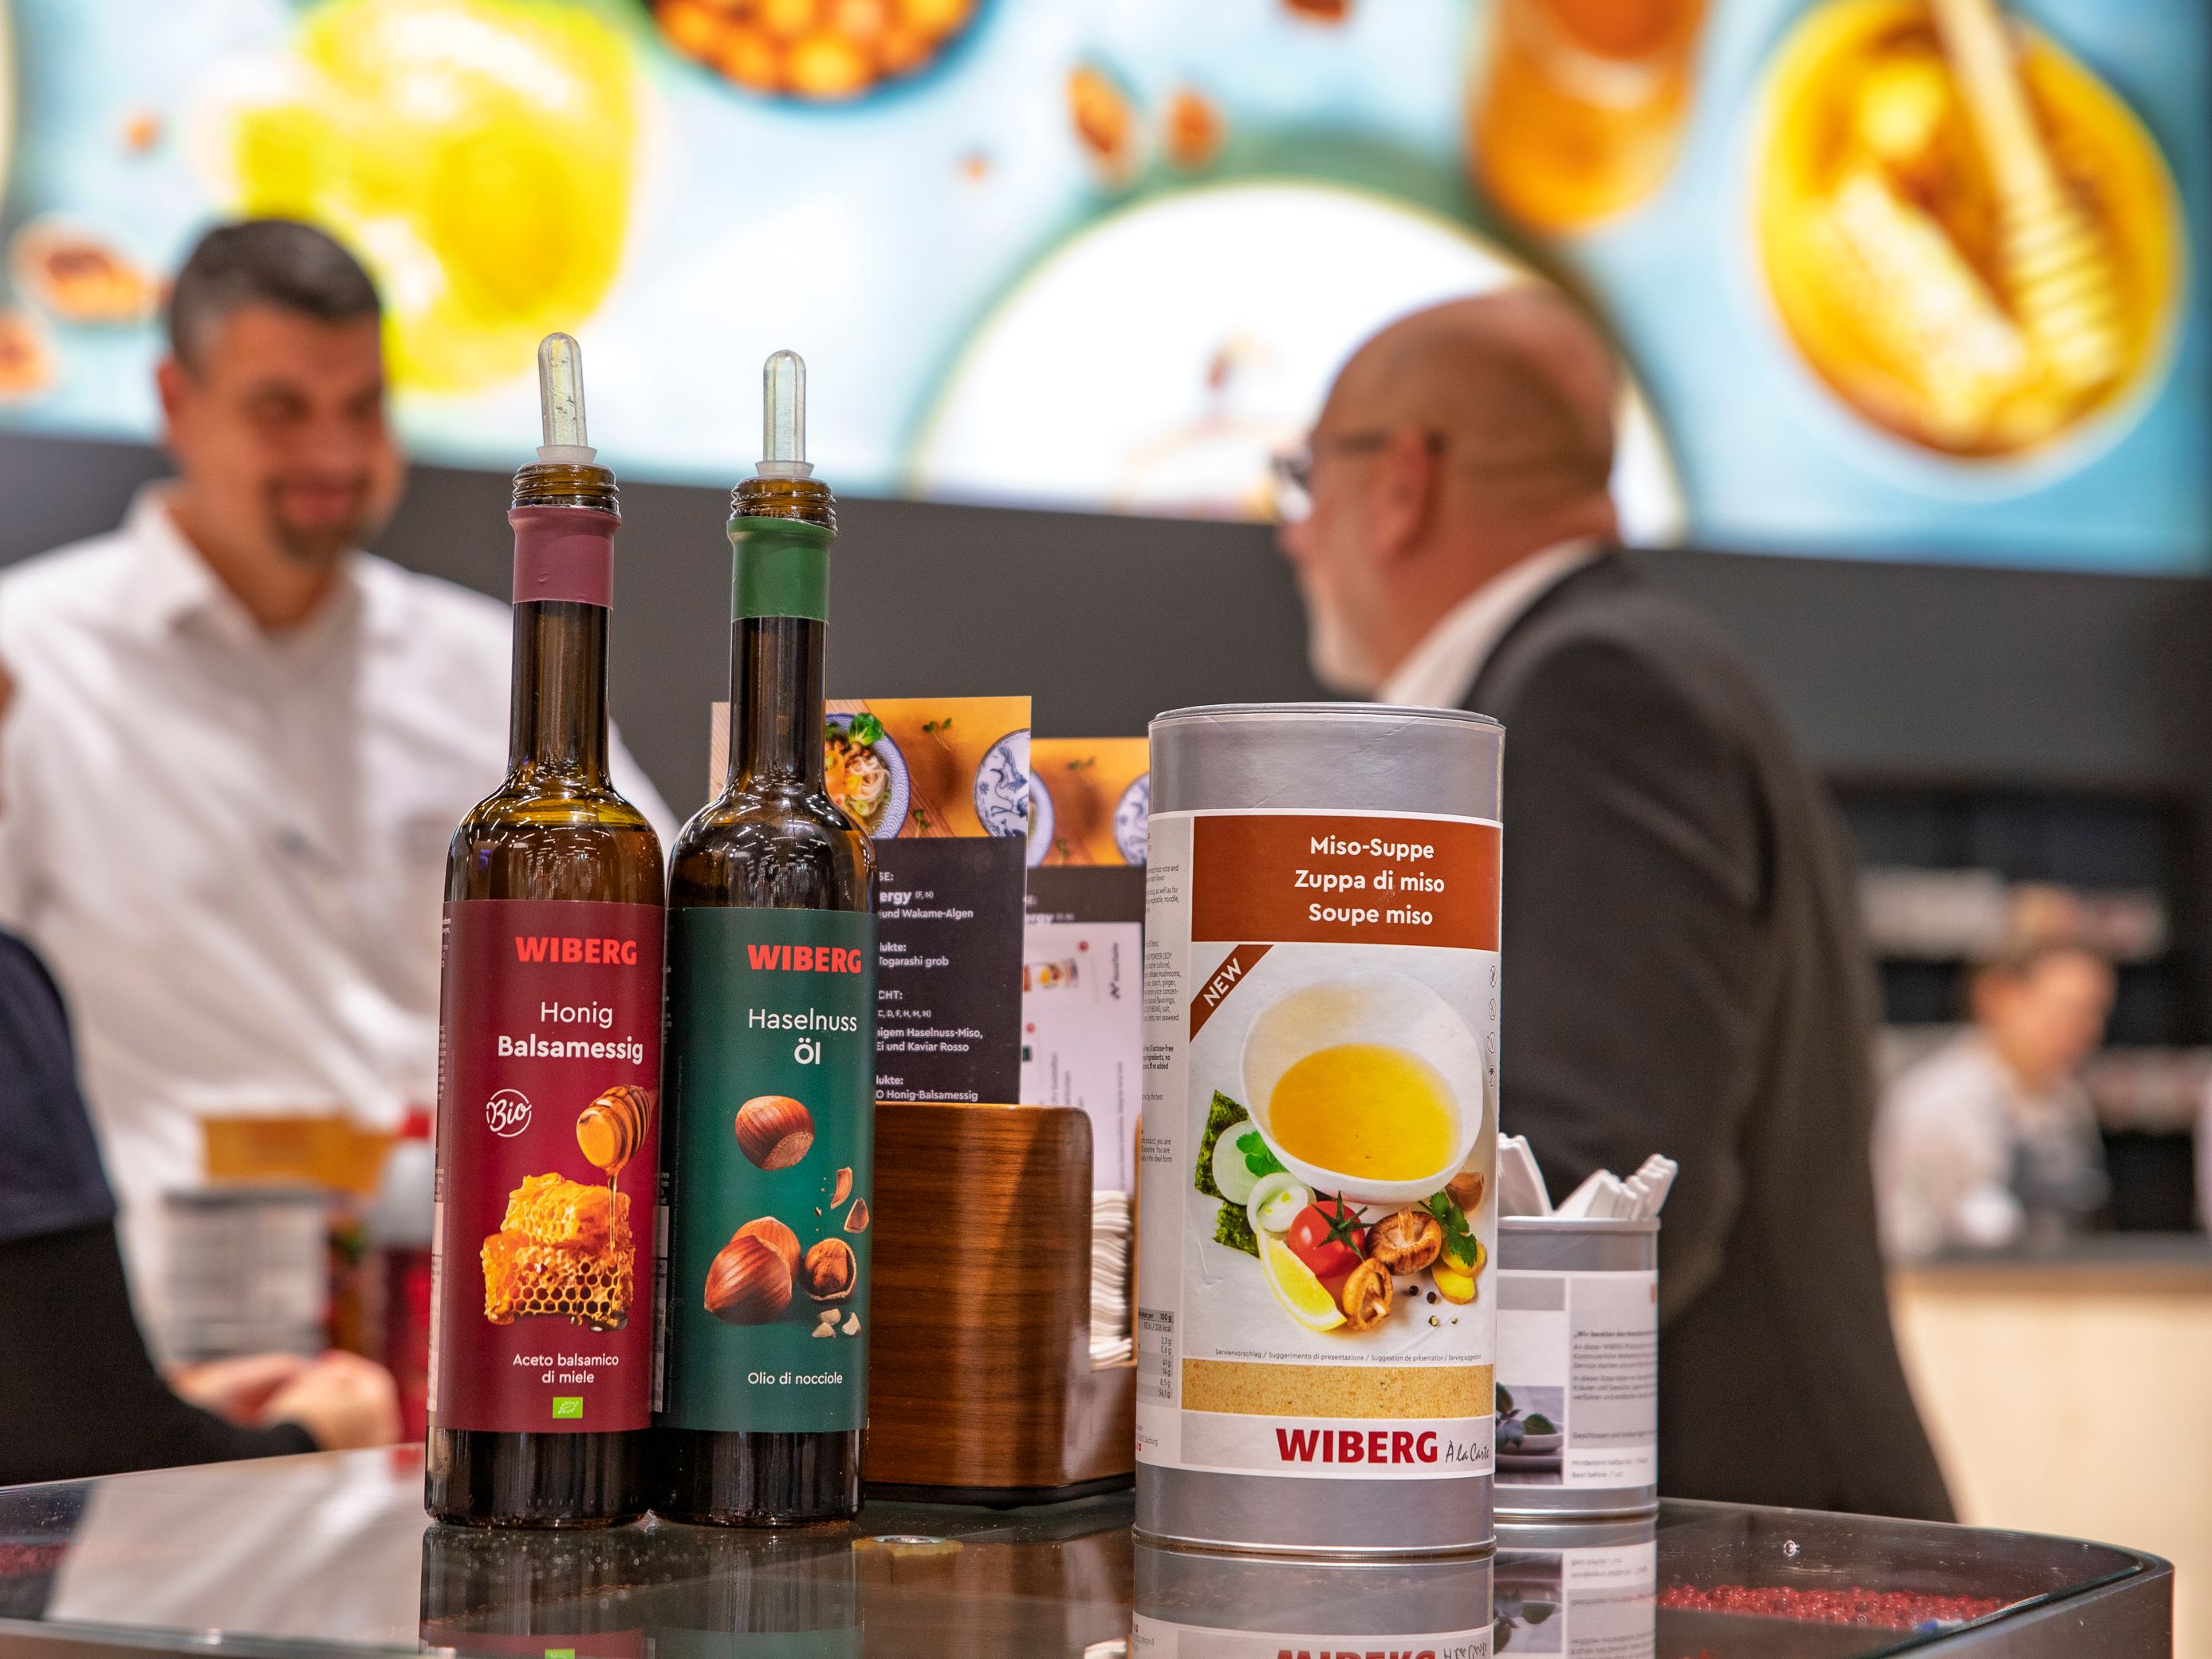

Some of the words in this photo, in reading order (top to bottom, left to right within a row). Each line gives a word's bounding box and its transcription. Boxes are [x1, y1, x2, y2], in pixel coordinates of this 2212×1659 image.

[1310, 835, 1435, 862] Miso-Suppe
[1294, 869, 1366, 894] Zuppa
[1373, 870, 1393, 891] di
[1399, 873, 1445, 893] miso
[902, 908, 974, 920] Wakame-Algen
[1308, 903, 1380, 927] Soupe
[1386, 904, 1433, 925] miso
[514, 936, 637, 966] WIBERG
[747, 944, 862, 974] WIBERG
[926, 956, 949, 967] grob
[1203, 957, 1243, 1007] NEW
[540, 1001, 613, 1027] Honig
[748, 1008, 857, 1032] Haselnuss
[907, 1027, 983, 1039] Haselnuss-Miso,
[498, 1034, 644, 1065] Balsamessig
[793, 1037, 821, 1065] Öl
[887, 1042, 905, 1051] und
[907, 1042, 938, 1051] Kaviar
[940, 1042, 970, 1052] Rosso
[888, 1090, 978, 1101] Honig-Balsamessig
[486, 1099, 532, 1132] Bio
[513, 1354, 553, 1368] Aceto
[557, 1354, 620, 1368] balsamico
[1215, 1349, 1261, 1358] Serviervorschlag
[541, 1370, 556, 1385] di
[559, 1370, 595, 1385] miele
[747, 1372, 775, 1385] Olio
[778, 1372, 792, 1385] di
[796, 1372, 843, 1385] nocciole
[1276, 1428, 1438, 1464] WIBERG
[1455, 1444, 1469, 1461] la
[1470, 1443, 1490, 1462] Carte
